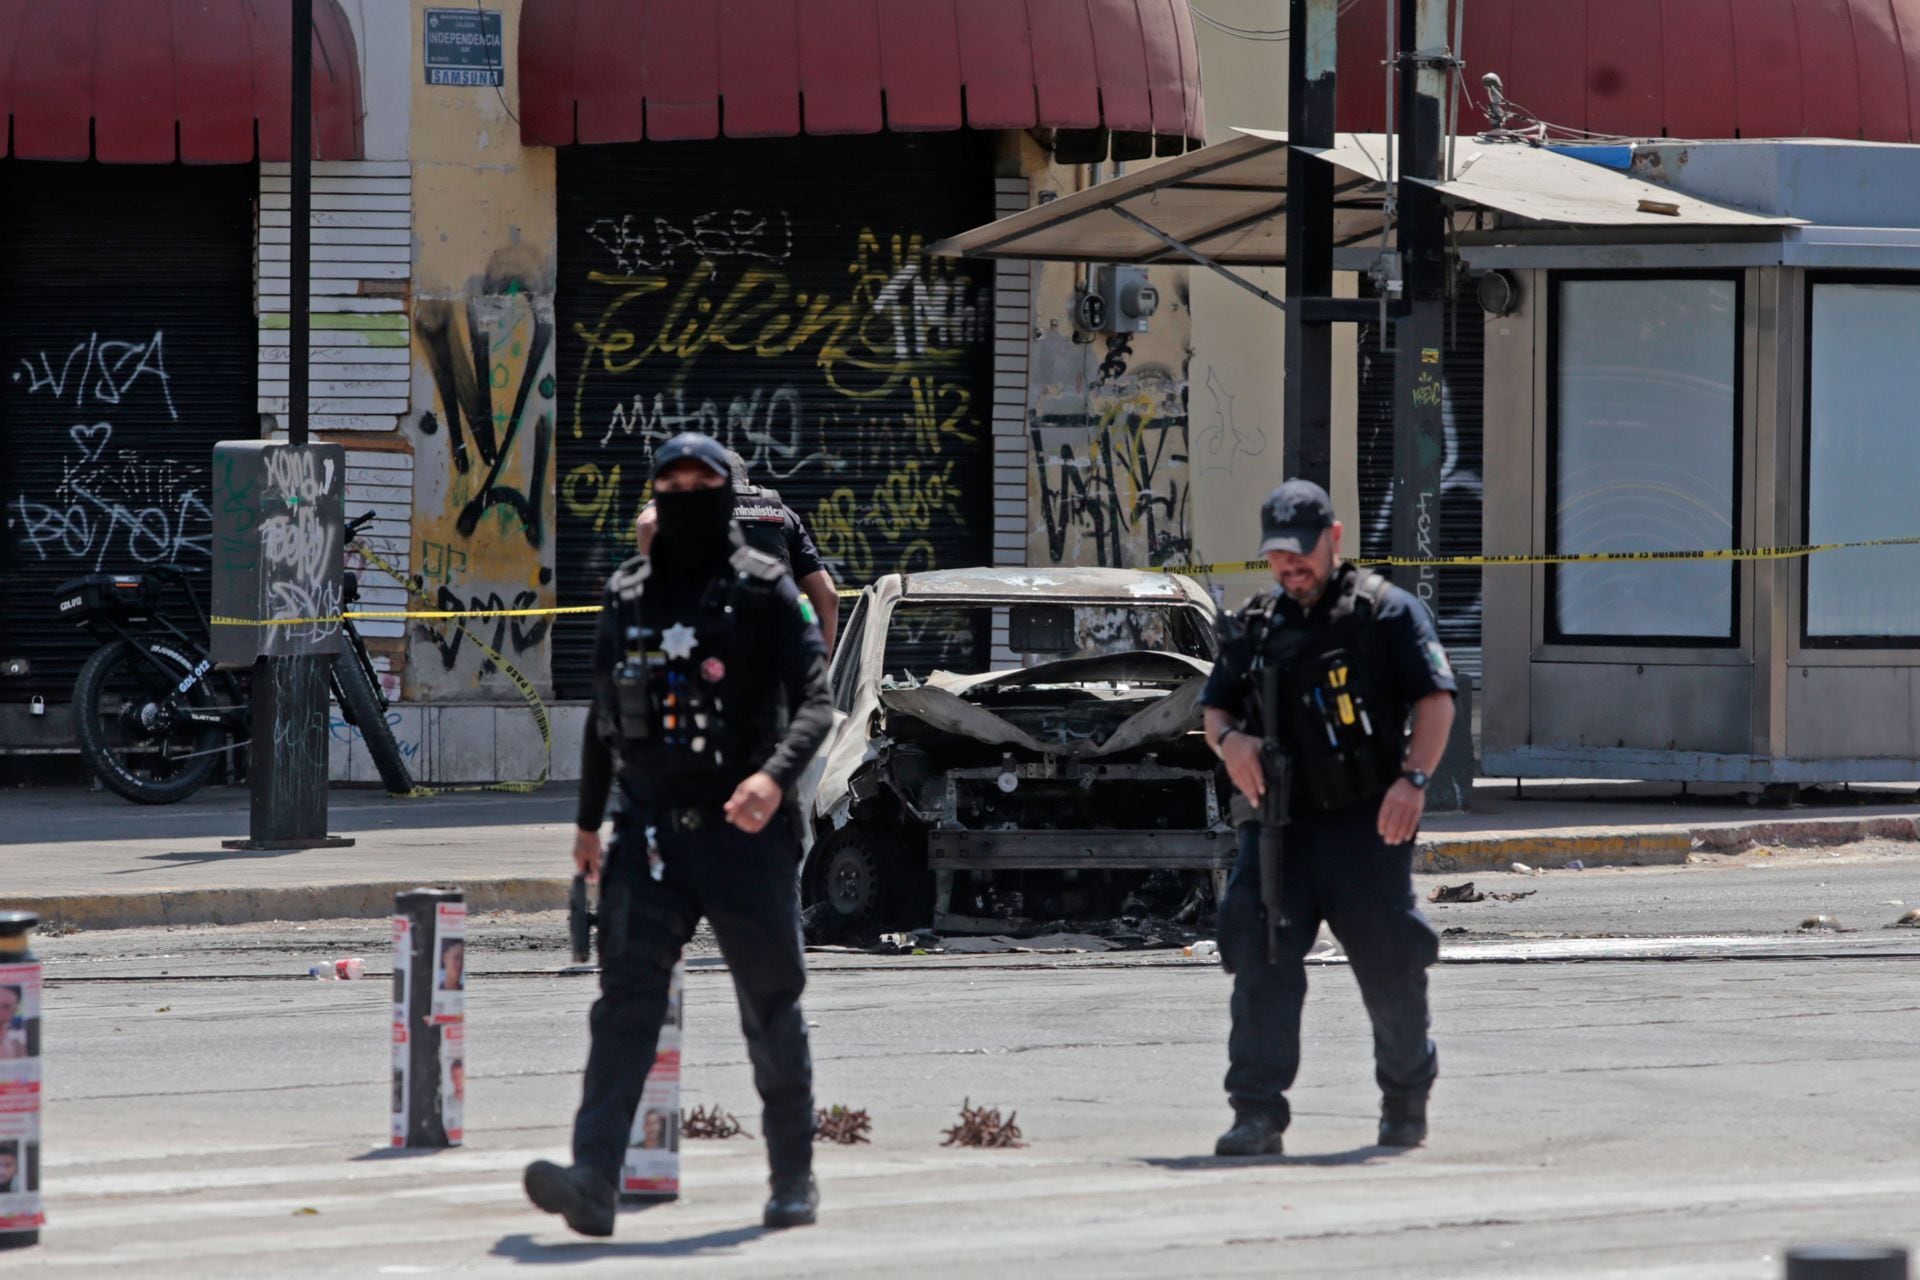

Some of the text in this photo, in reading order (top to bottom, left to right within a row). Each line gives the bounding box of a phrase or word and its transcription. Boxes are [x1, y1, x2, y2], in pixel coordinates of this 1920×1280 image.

[429, 31, 500, 46] INDEPENDENCIA
[434, 70, 497, 85] SAMSUNG
[179, 660, 210, 693] GDL 012
[506, 665, 528, 688] PASO
